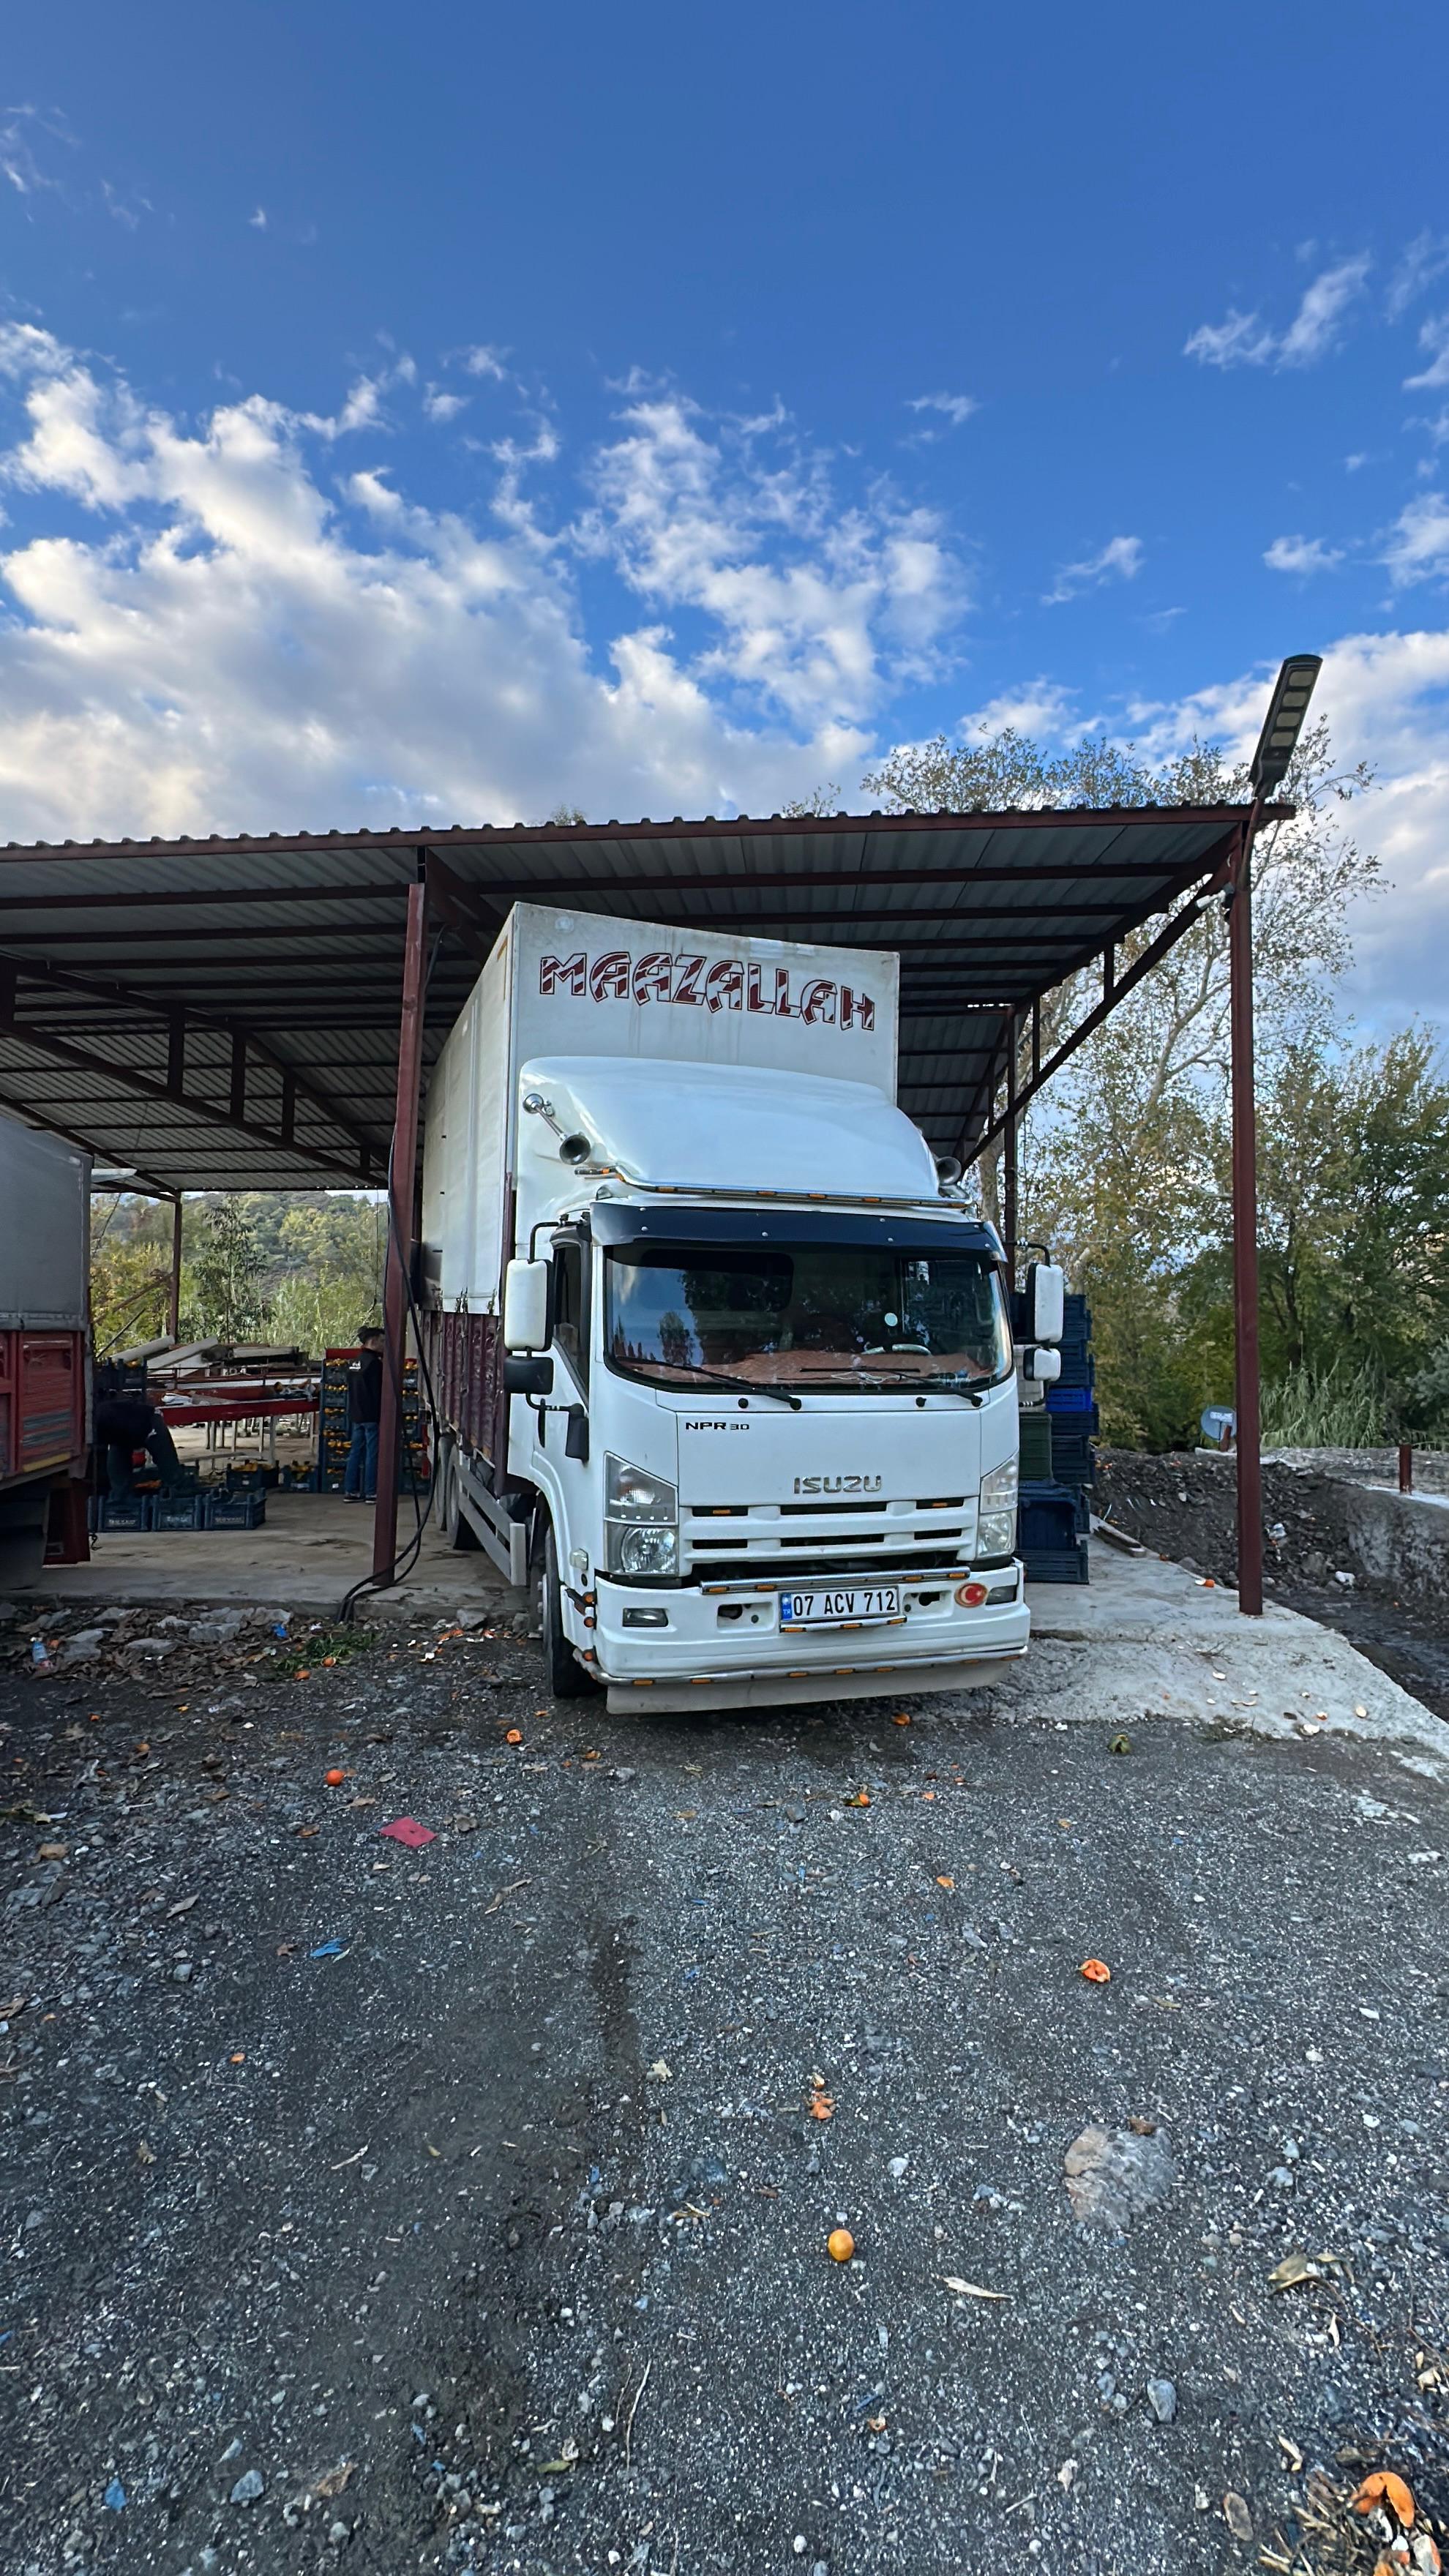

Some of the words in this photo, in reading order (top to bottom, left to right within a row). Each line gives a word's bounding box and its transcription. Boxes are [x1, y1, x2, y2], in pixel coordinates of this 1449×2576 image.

[539, 951, 875, 1031] MAAZALLAH
[685, 1422, 727, 1430] NPR
[793, 1475, 882, 1494] ISUZU
[793, 1595, 814, 1617] 07
[824, 1592, 855, 1614] ACV
[864, 1590, 896, 1612] 712
